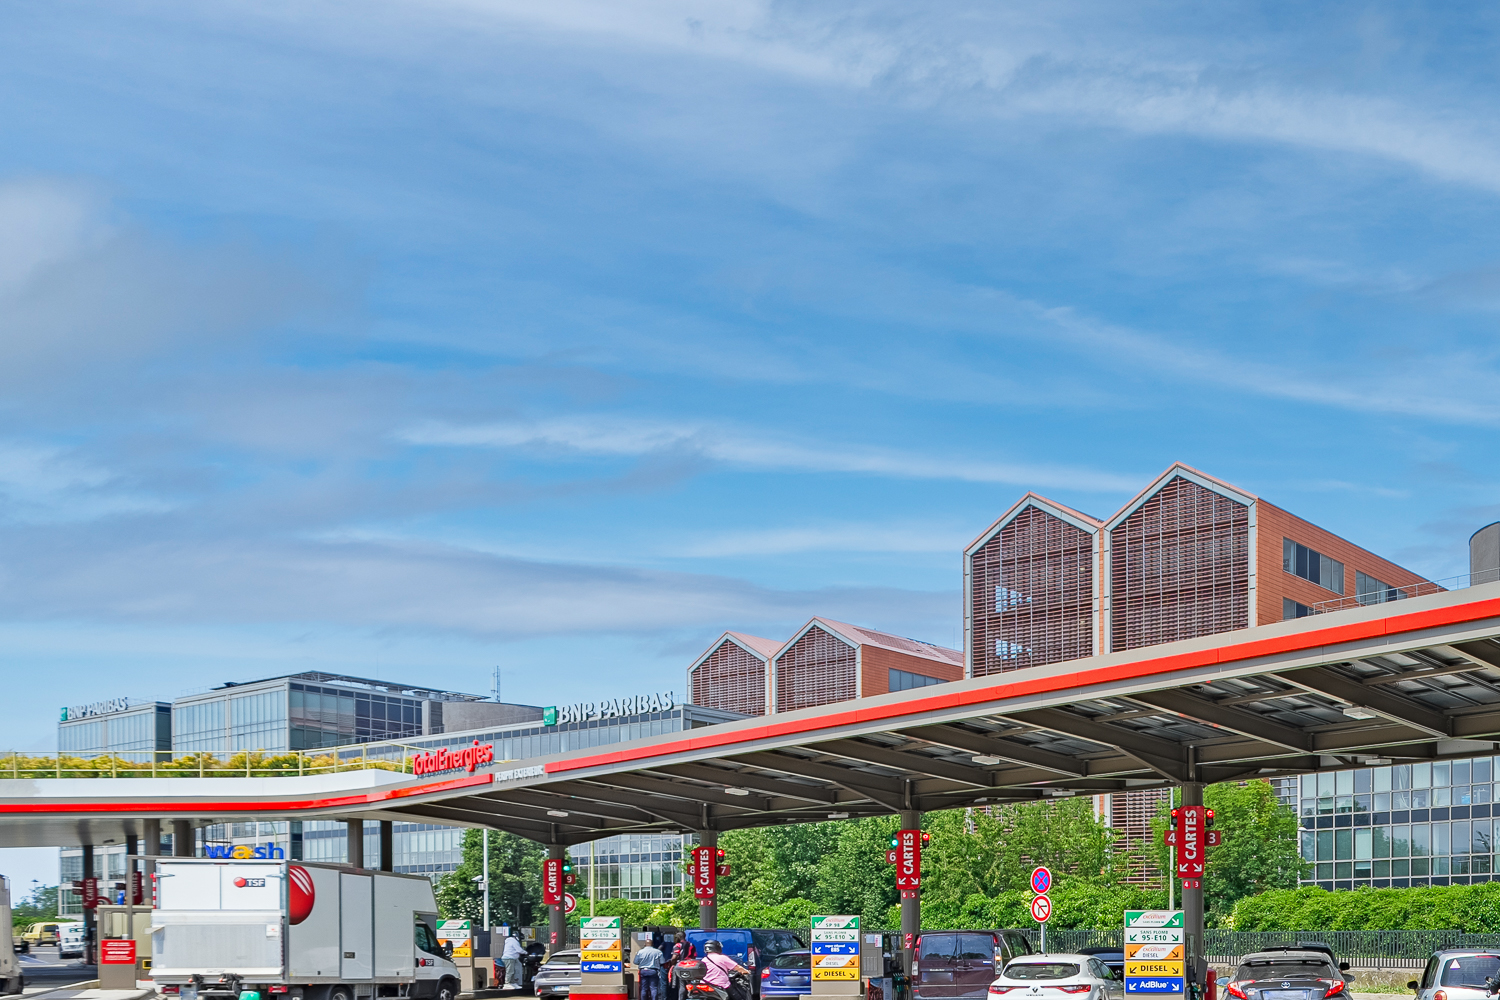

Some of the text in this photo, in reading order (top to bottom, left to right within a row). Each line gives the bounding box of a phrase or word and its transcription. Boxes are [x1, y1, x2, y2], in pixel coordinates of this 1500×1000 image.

[67, 697, 128, 719] BNP PARIBAS
[558, 690, 674, 723] BNP PARIBAS
[411, 739, 493, 775] TotalEnergies
[1168, 832, 1176, 843] 4
[1185, 809, 1197, 860] CARTES
[1208, 832, 1216, 844] 3
[889, 852, 896, 862] 6
[903, 833, 914, 874] CARTES
[689, 865, 695, 874] 8
[700, 849, 709, 885] CARTES
[720, 866, 727, 874] 7
[247, 879, 265, 887] TSF
[548, 861, 557, 893] CARTES
[566, 875, 572, 883] 9
